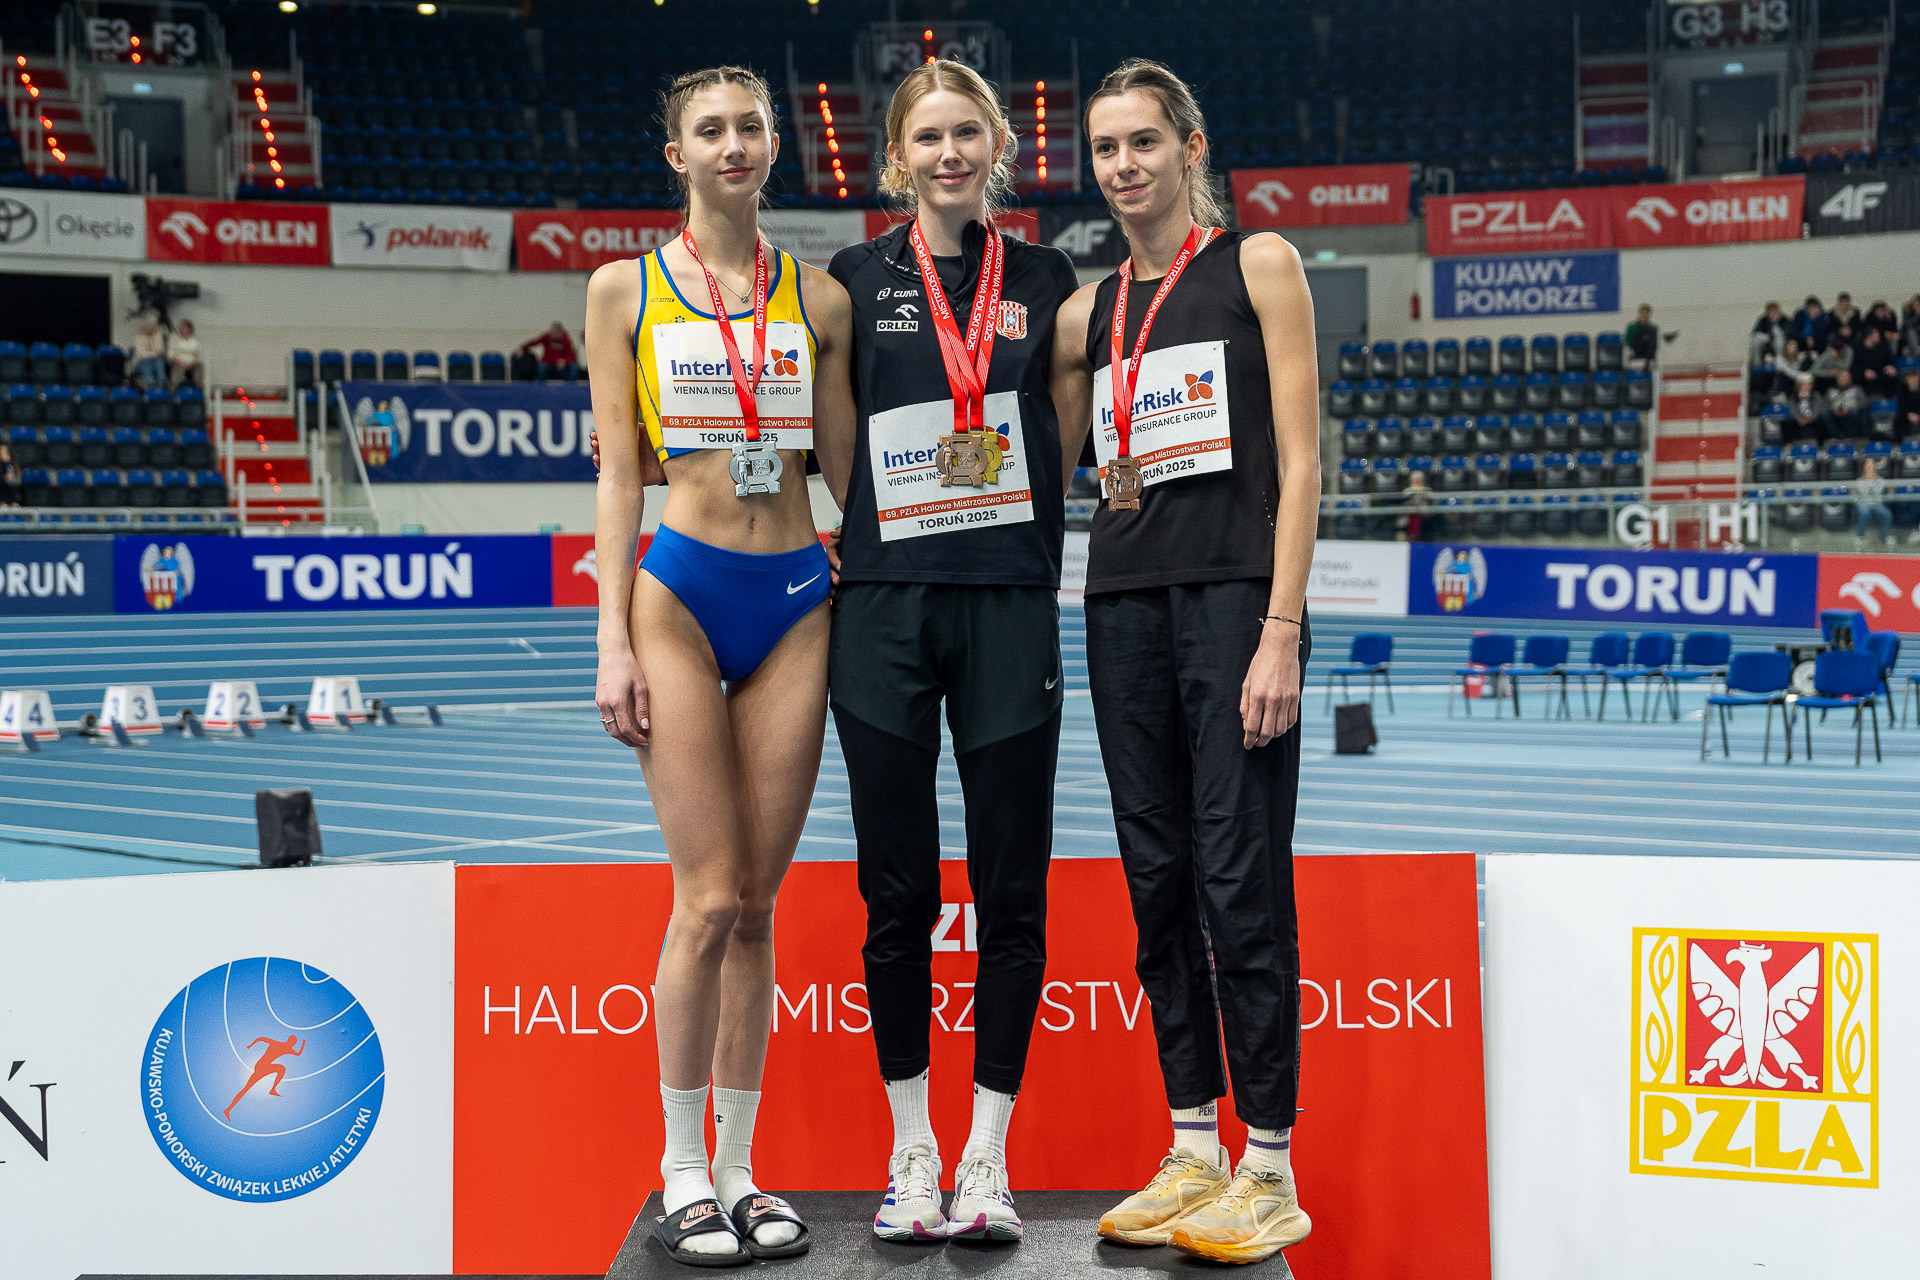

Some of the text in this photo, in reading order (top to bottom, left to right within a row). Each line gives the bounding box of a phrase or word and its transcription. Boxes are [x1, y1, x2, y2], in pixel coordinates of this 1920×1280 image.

[1672, 0, 1788, 38] G3 H3
[153, 22, 198, 57] F3
[1309, 183, 1390, 206] ORLEN
[1820, 181, 1888, 221] 4F
[1451, 198, 1584, 235] PZLA
[1685, 195, 1788, 226] ORLEN
[56, 213, 135, 239] Okęcie
[215, 217, 318, 246] ORLEN
[386, 223, 492, 252] polanik
[1053, 219, 1113, 256] 4F
[912, 229, 926, 258] POLSKI
[1455, 258, 1574, 287] KUJAWY
[921, 256, 951, 320] MISTRZOSTWA
[1455, 284, 1598, 314] POMORZE
[972, 294, 986, 327] POLSKI
[987, 287, 1000, 319] POLSKI
[1130, 249, 1190, 371] MISTRZOSTWA POLSKI 2025
[878, 321, 917, 330] ORLEN
[966, 327, 978, 351] 2025
[983, 320, 995, 342] 2025
[673, 386, 710, 396] VIENNA
[768, 386, 802, 396] GROUP
[668, 418, 682, 427] 69.
[683, 418, 702, 427] PZLA
[703, 418, 734, 427] Halowe
[784, 418, 809, 427] Polski
[1134, 414, 1181, 434] INSURANCE
[1183, 409, 1217, 422] GROUP
[700, 430, 744, 443] TORUŃ
[1155, 445, 1200, 460] Mistrzostwa
[1201, 440, 1226, 450] Polski
[888, 473, 924, 487] VIENNA
[1166, 458, 1196, 474] 2025
[885, 491, 1027, 519] 69. PZLA Halowe Mistrzostwa Polski
[918, 510, 998, 530] TORUŃ 2025
[1616, 500, 1760, 545] G1 H1
[252, 542, 473, 602] TORUŃ
[1546, 557, 1776, 617] TORUŃ
[28, 702, 45, 726] 4
[133, 696, 148, 720] 3
[215, 692, 252, 716] 2 2
[340, 689, 351, 710] 1
[484, 984, 656, 1036] HALO
[1298, 978, 1452, 1030] OLSKI
[149, 1027, 372, 1197] KUJAWSKO-POMORSKI ZWIĄZEK LEKKIEJ ATLETYKI
[1643, 1094, 1864, 1173] PZLA
[685, 1203, 716, 1220] NIKE
